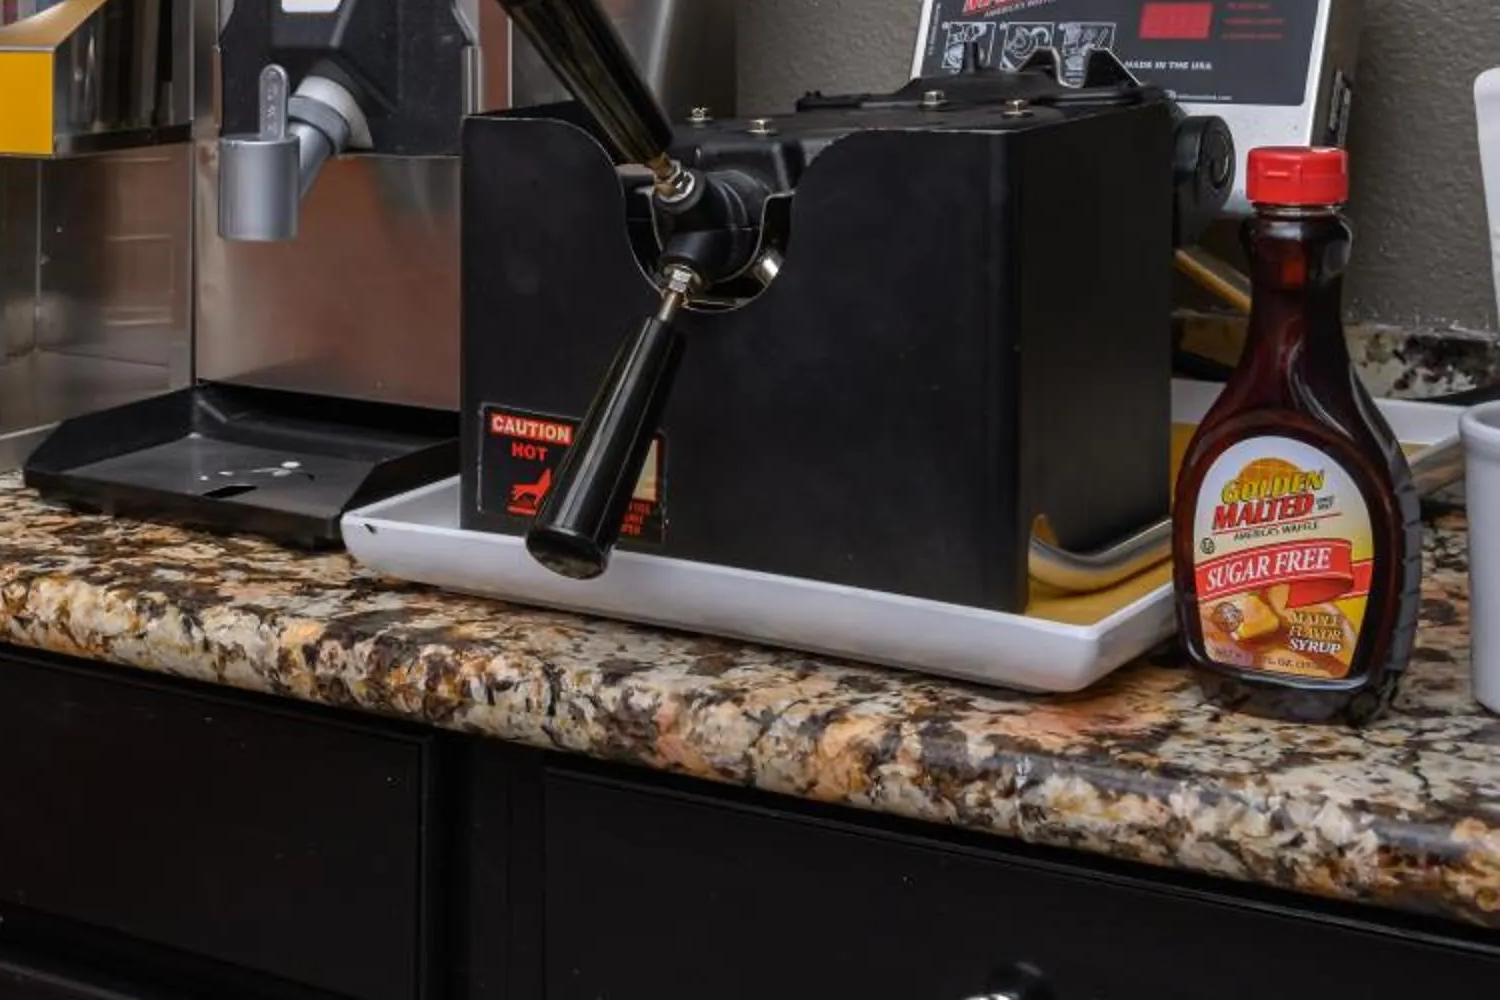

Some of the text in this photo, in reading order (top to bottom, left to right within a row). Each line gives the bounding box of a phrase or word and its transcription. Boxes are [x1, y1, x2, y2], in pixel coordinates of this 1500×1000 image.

[491, 413, 573, 444] CAUTION
[511, 441, 548, 461] HOT
[1221, 469, 1325, 505] GOLDEN
[1213, 494, 1315, 530] MALTED
[1206, 547, 1332, 592] SUGAR FREE
[1290, 610, 1341, 626] MAPLE
[1289, 625, 1342, 641] FLAVOR
[1289, 637, 1342, 655] SYRUP
